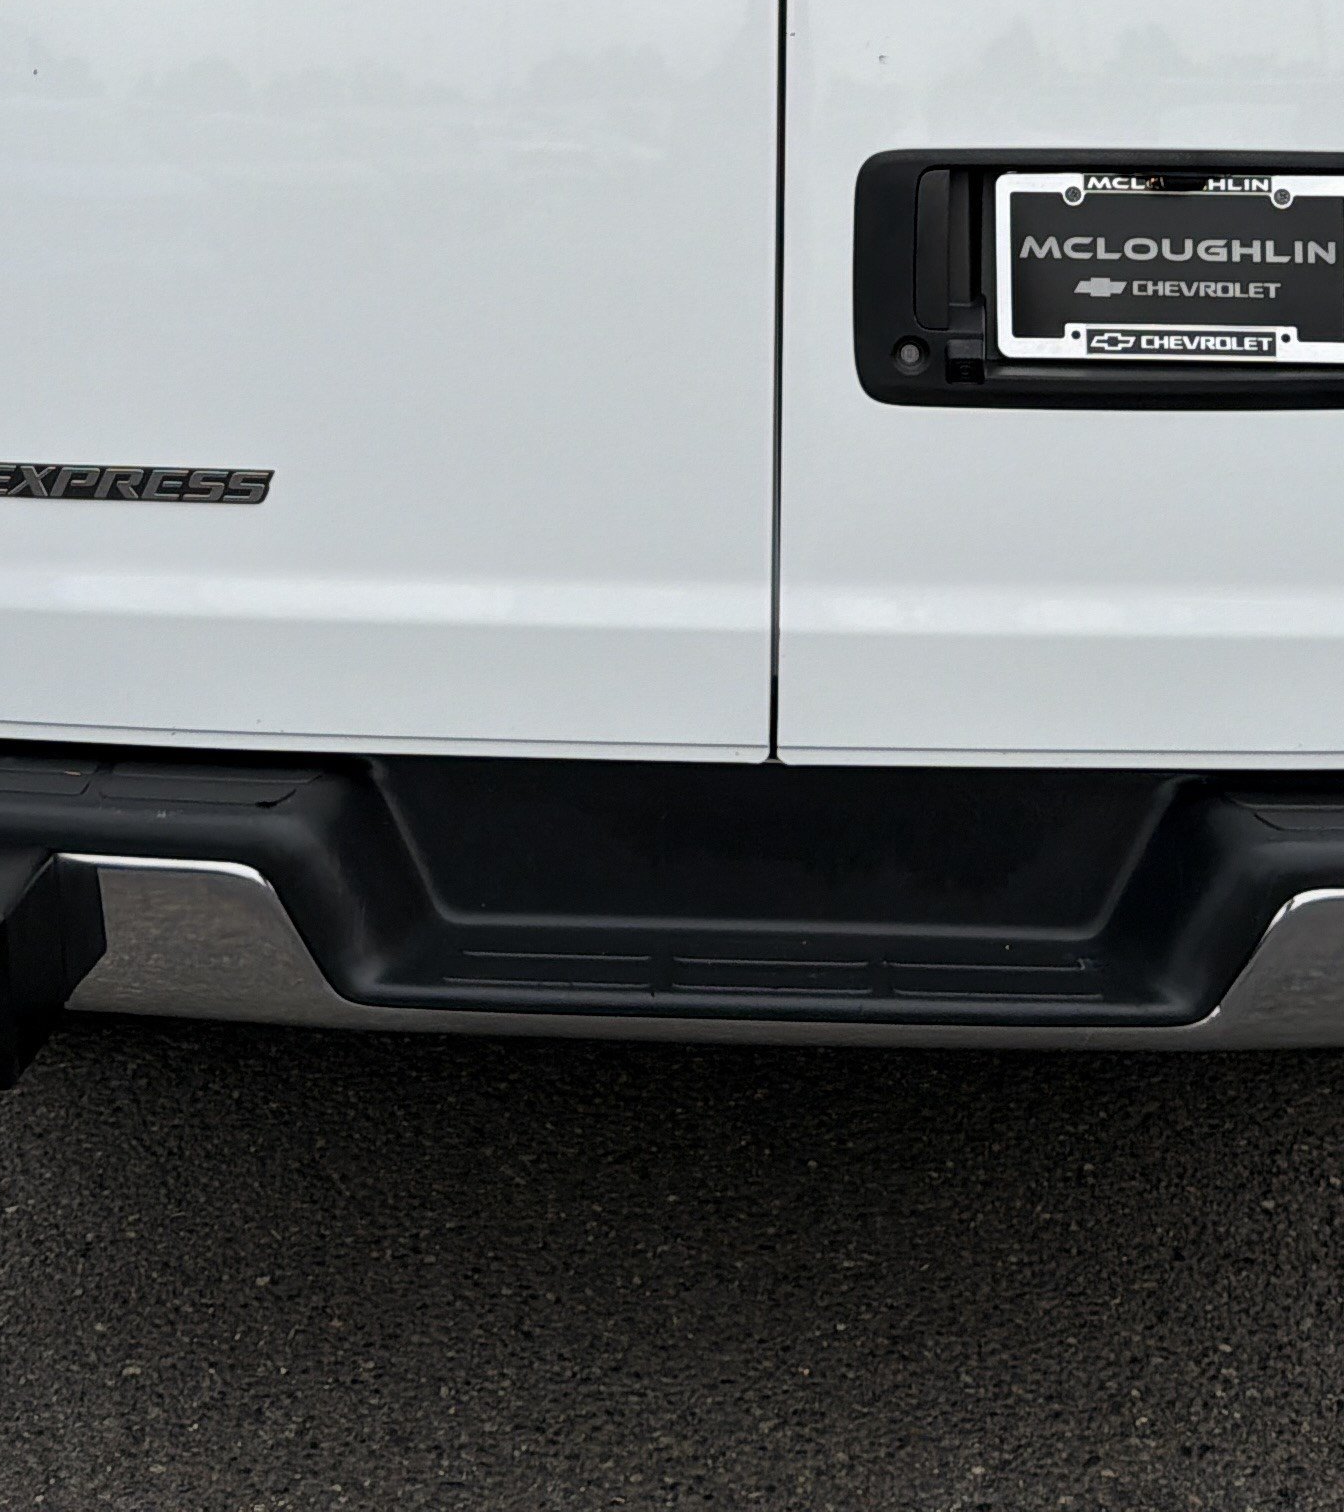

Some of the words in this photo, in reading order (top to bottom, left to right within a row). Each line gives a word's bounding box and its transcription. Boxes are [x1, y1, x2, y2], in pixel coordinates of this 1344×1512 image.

[1087, 175, 1269, 193] MCLHLIN
[1020, 235, 1337, 265] MCLOUGHLIN
[1132, 281, 1281, 299] CHEVROLET
[1140, 335, 1273, 353] CHEVROLET
